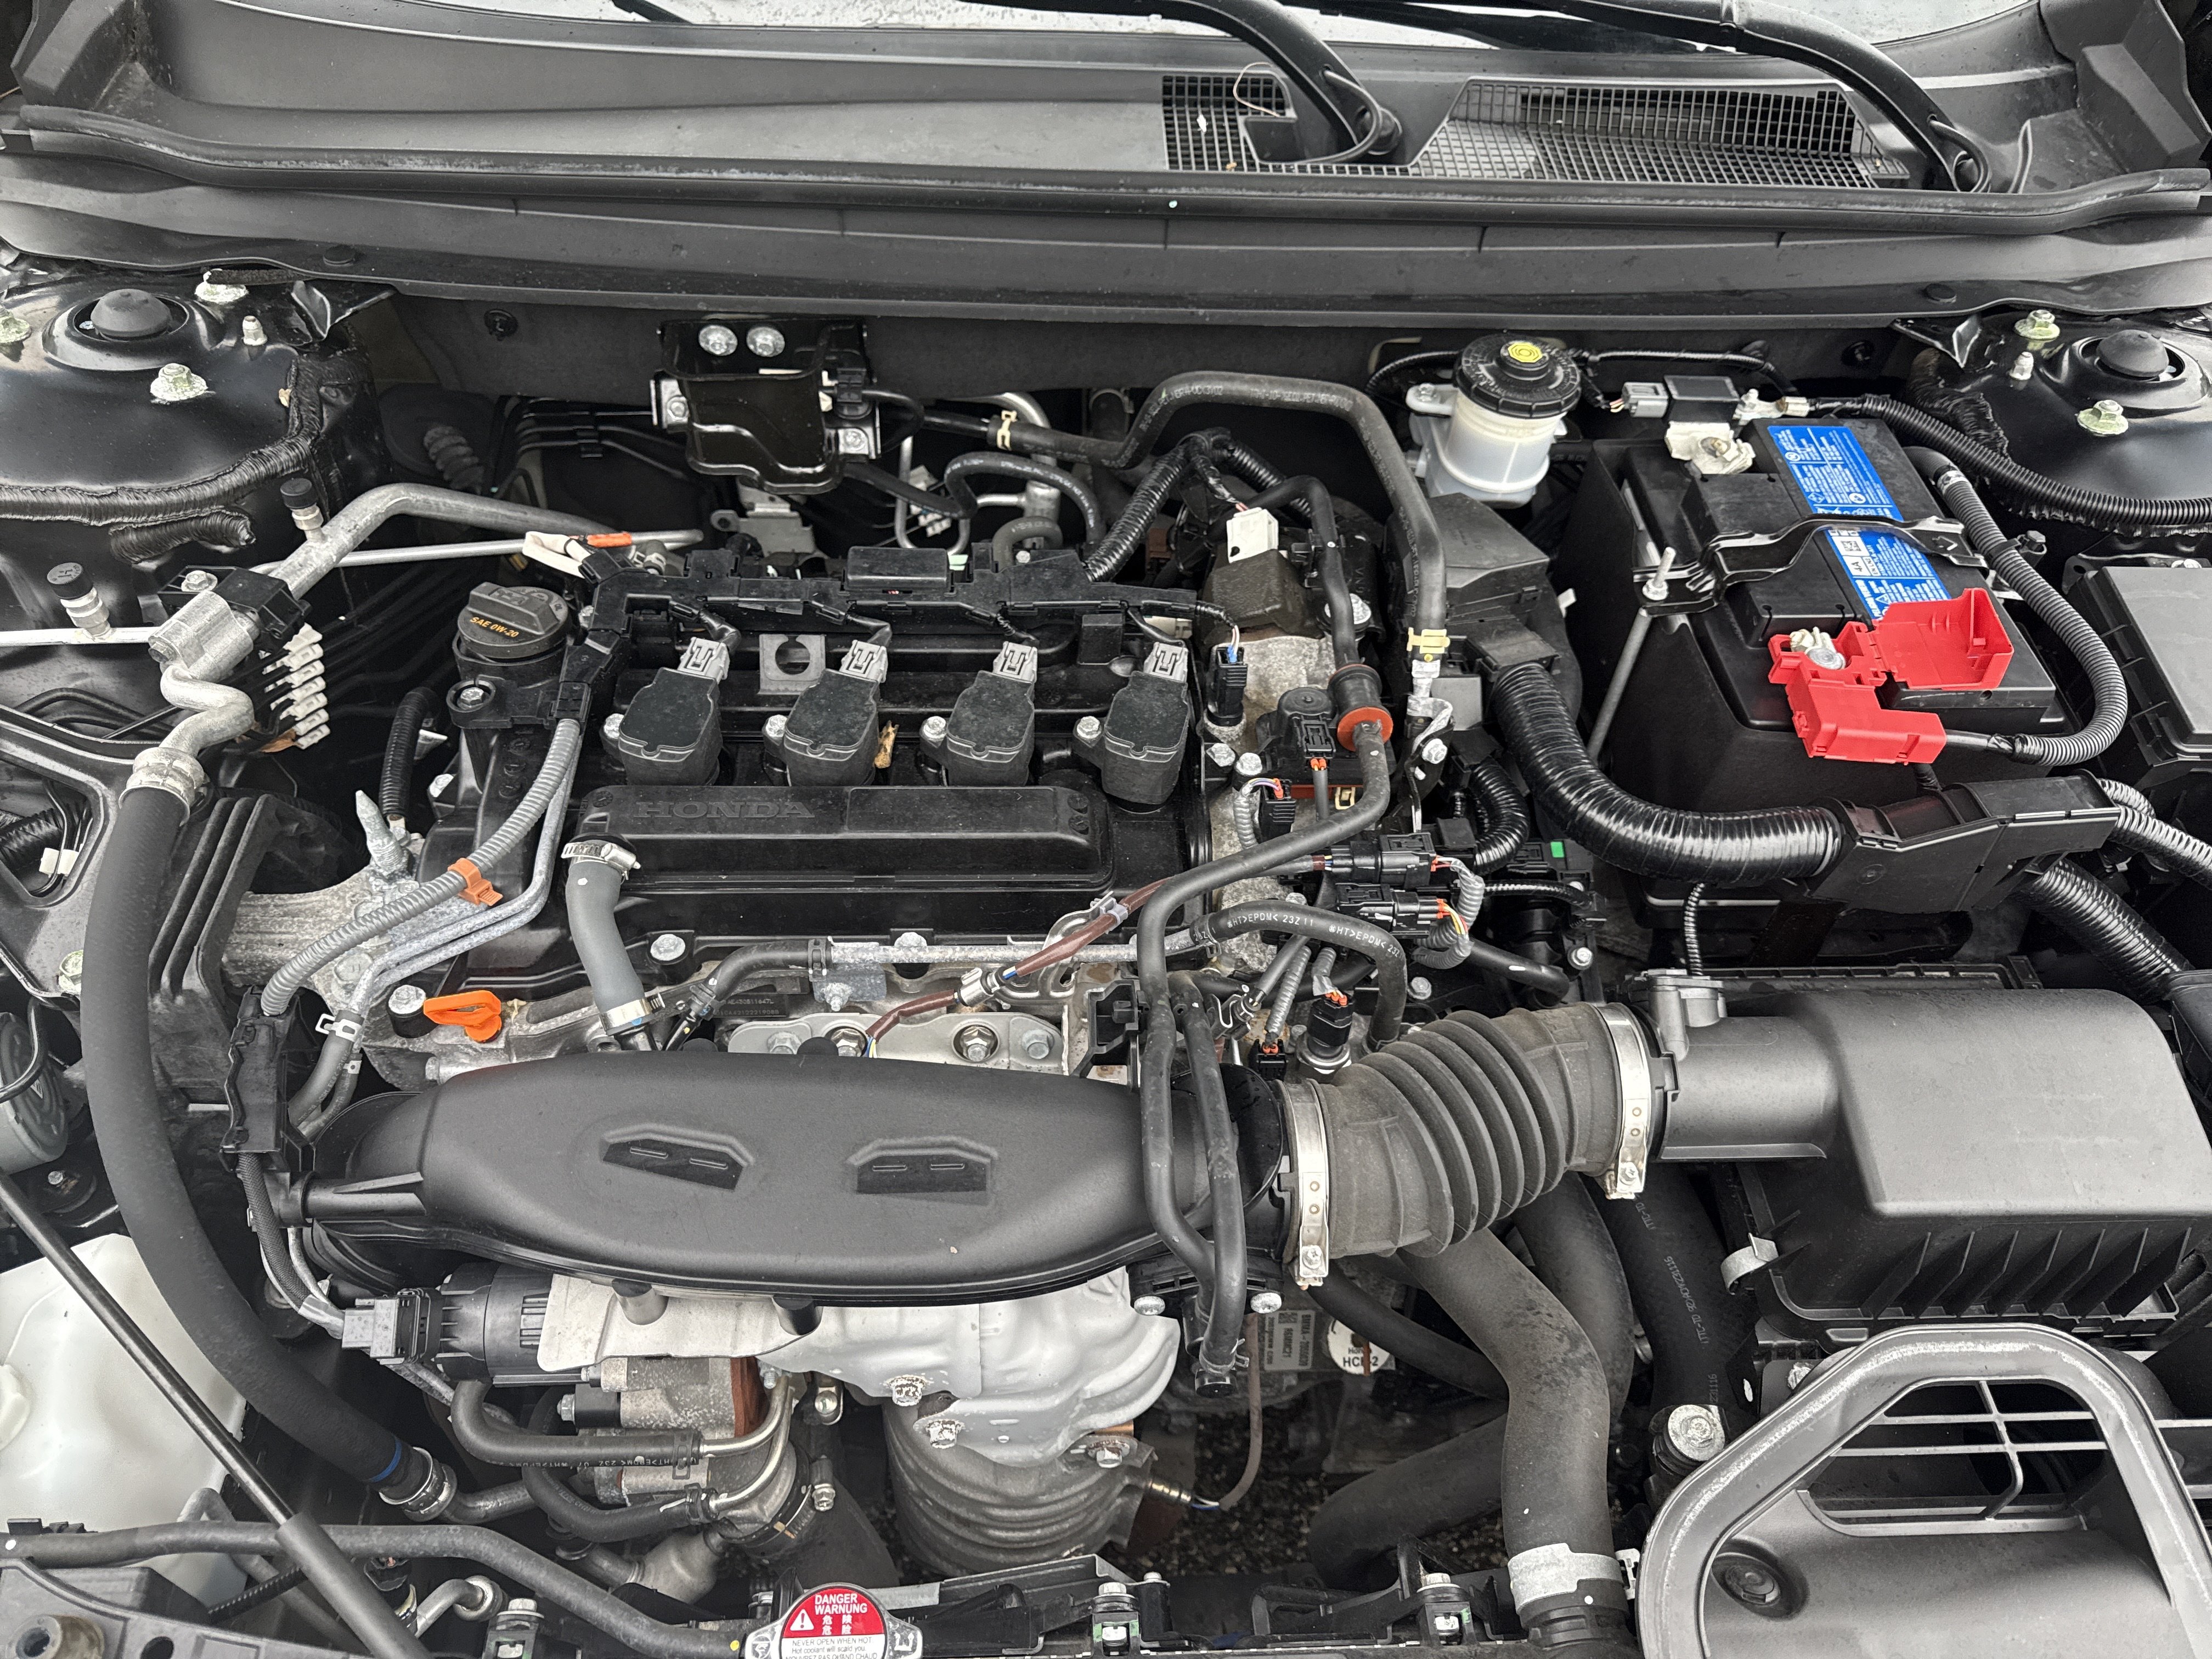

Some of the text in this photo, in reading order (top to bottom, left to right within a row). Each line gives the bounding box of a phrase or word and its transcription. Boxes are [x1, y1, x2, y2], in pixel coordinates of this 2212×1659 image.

[470, 617, 519, 637] SAE 0W-20
[634, 802, 815, 818] HONDA
[815, 1593, 858, 1605] DANGER
[815, 1603, 868, 1615] WARNUNG
